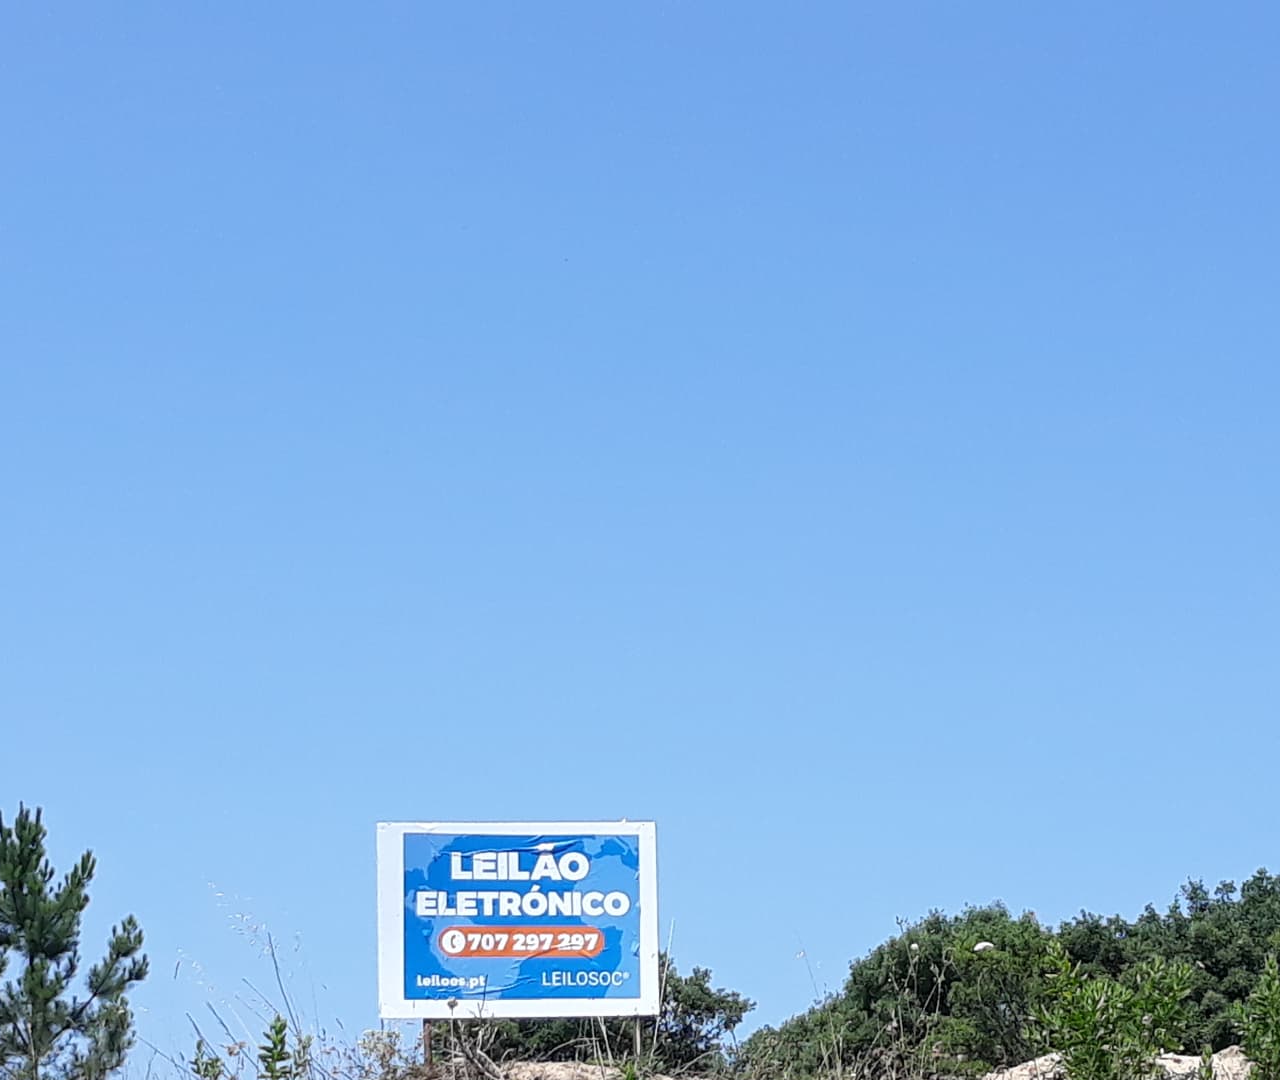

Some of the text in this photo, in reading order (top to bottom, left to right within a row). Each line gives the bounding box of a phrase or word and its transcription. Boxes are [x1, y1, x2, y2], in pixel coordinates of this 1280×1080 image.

[451, 843, 590, 881] LEILÃO
[416, 885, 630, 916] ELETRÓNICO
[467, 933, 598, 951] 707 297 297
[416, 974, 486, 988] leiloes.pt
